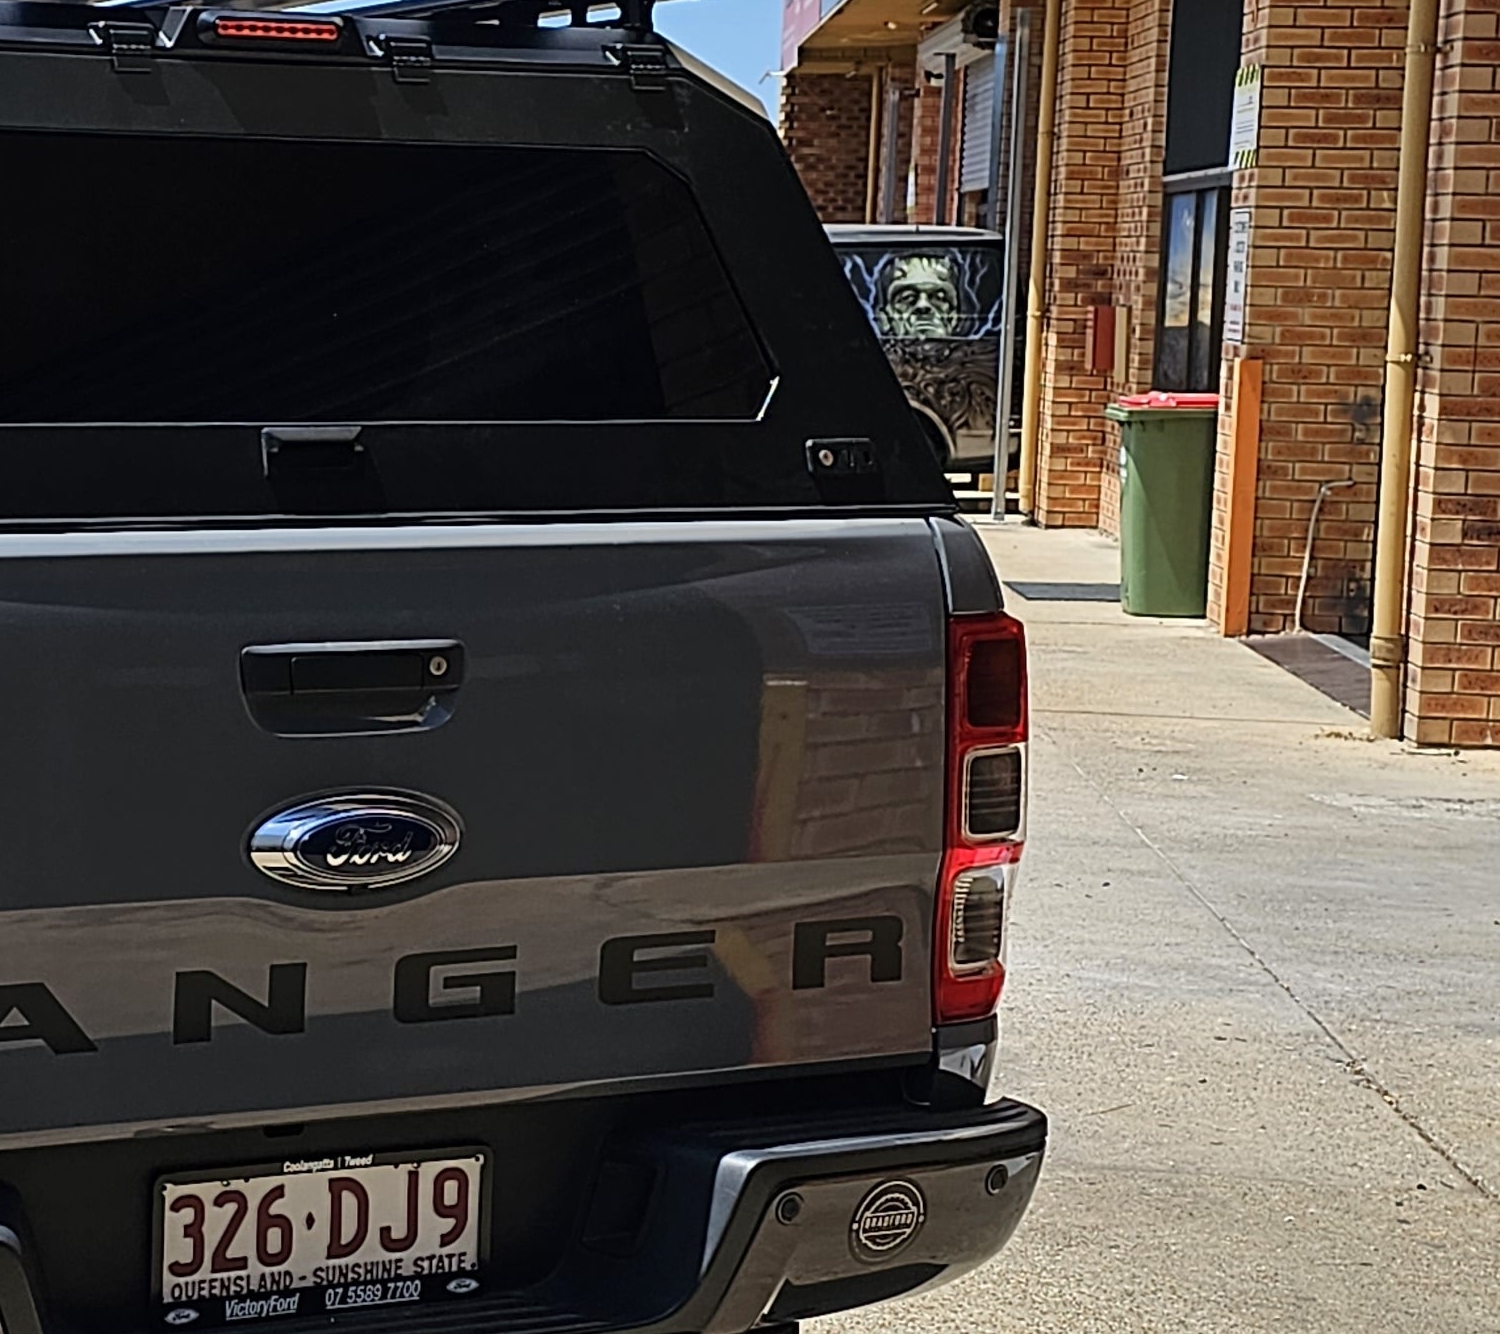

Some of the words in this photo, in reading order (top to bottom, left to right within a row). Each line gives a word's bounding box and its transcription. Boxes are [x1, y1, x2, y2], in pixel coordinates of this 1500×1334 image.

[325, 820, 414, 868] Ford
[345, 1154, 374, 1168] Tweed
[171, 1271, 294, 1301] QUEENSLAND
[312, 1258, 404, 1286] SUNSHINE
[412, 1251, 468, 1275] STATE
[325, 1287, 341, 1305] 07
[346, 1283, 383, 1303] 5589
[386, 1279, 421, 1299] 7700
